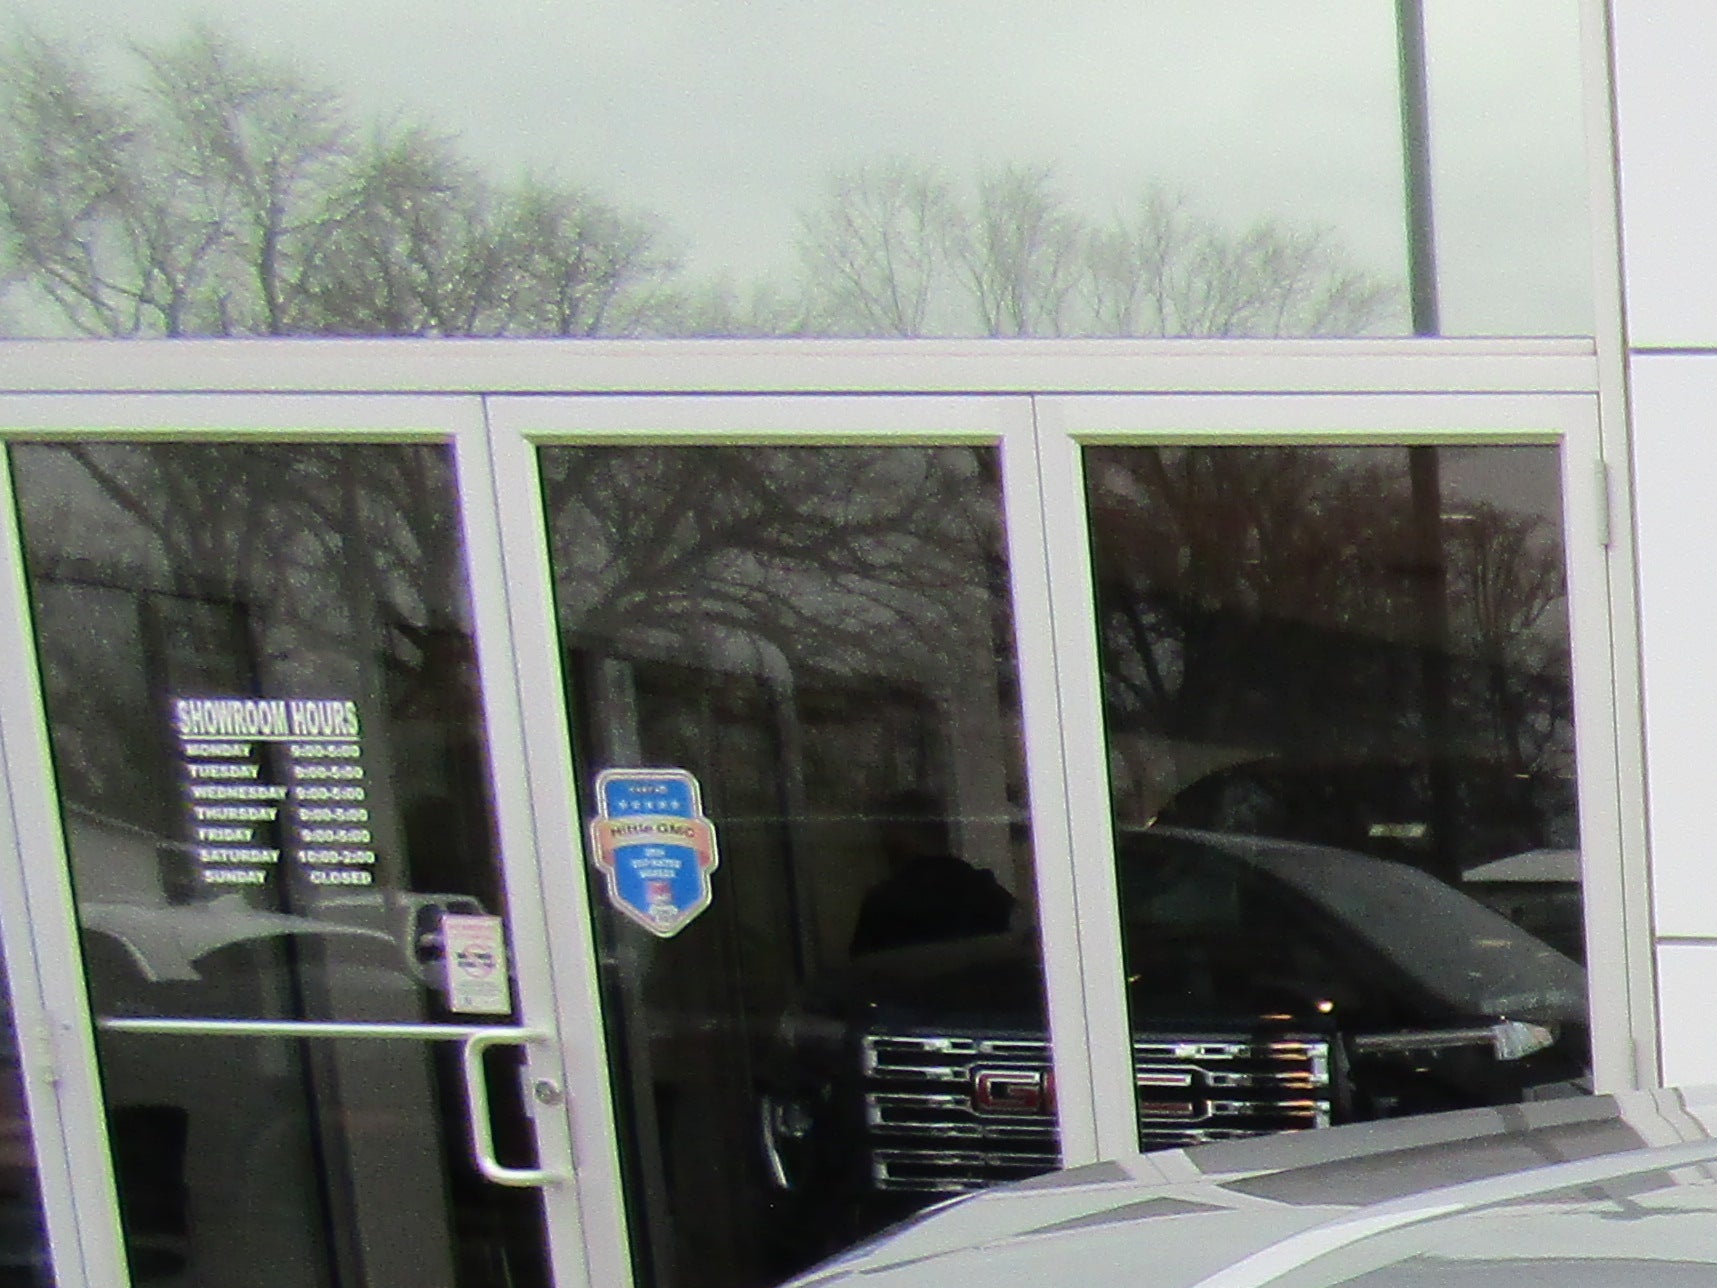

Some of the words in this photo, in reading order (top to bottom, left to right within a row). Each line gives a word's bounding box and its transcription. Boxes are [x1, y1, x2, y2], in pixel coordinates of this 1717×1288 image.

[175, 700, 290, 735] SHOWROOM
[291, 700, 360, 736] HOURS
[184, 744, 250, 757] MONDAY
[188, 764, 259, 779] TUESDAY
[191, 785, 287, 799] WEDNESDAY
[194, 806, 278, 821] THURSDAY
[197, 828, 253, 842] FRIDAY
[198, 849, 280, 863] SATURDAY
[202, 870, 266, 884] SUNDAY
[310, 871, 373, 885] CLOSED
[974, 1069, 1194, 1117] GC
